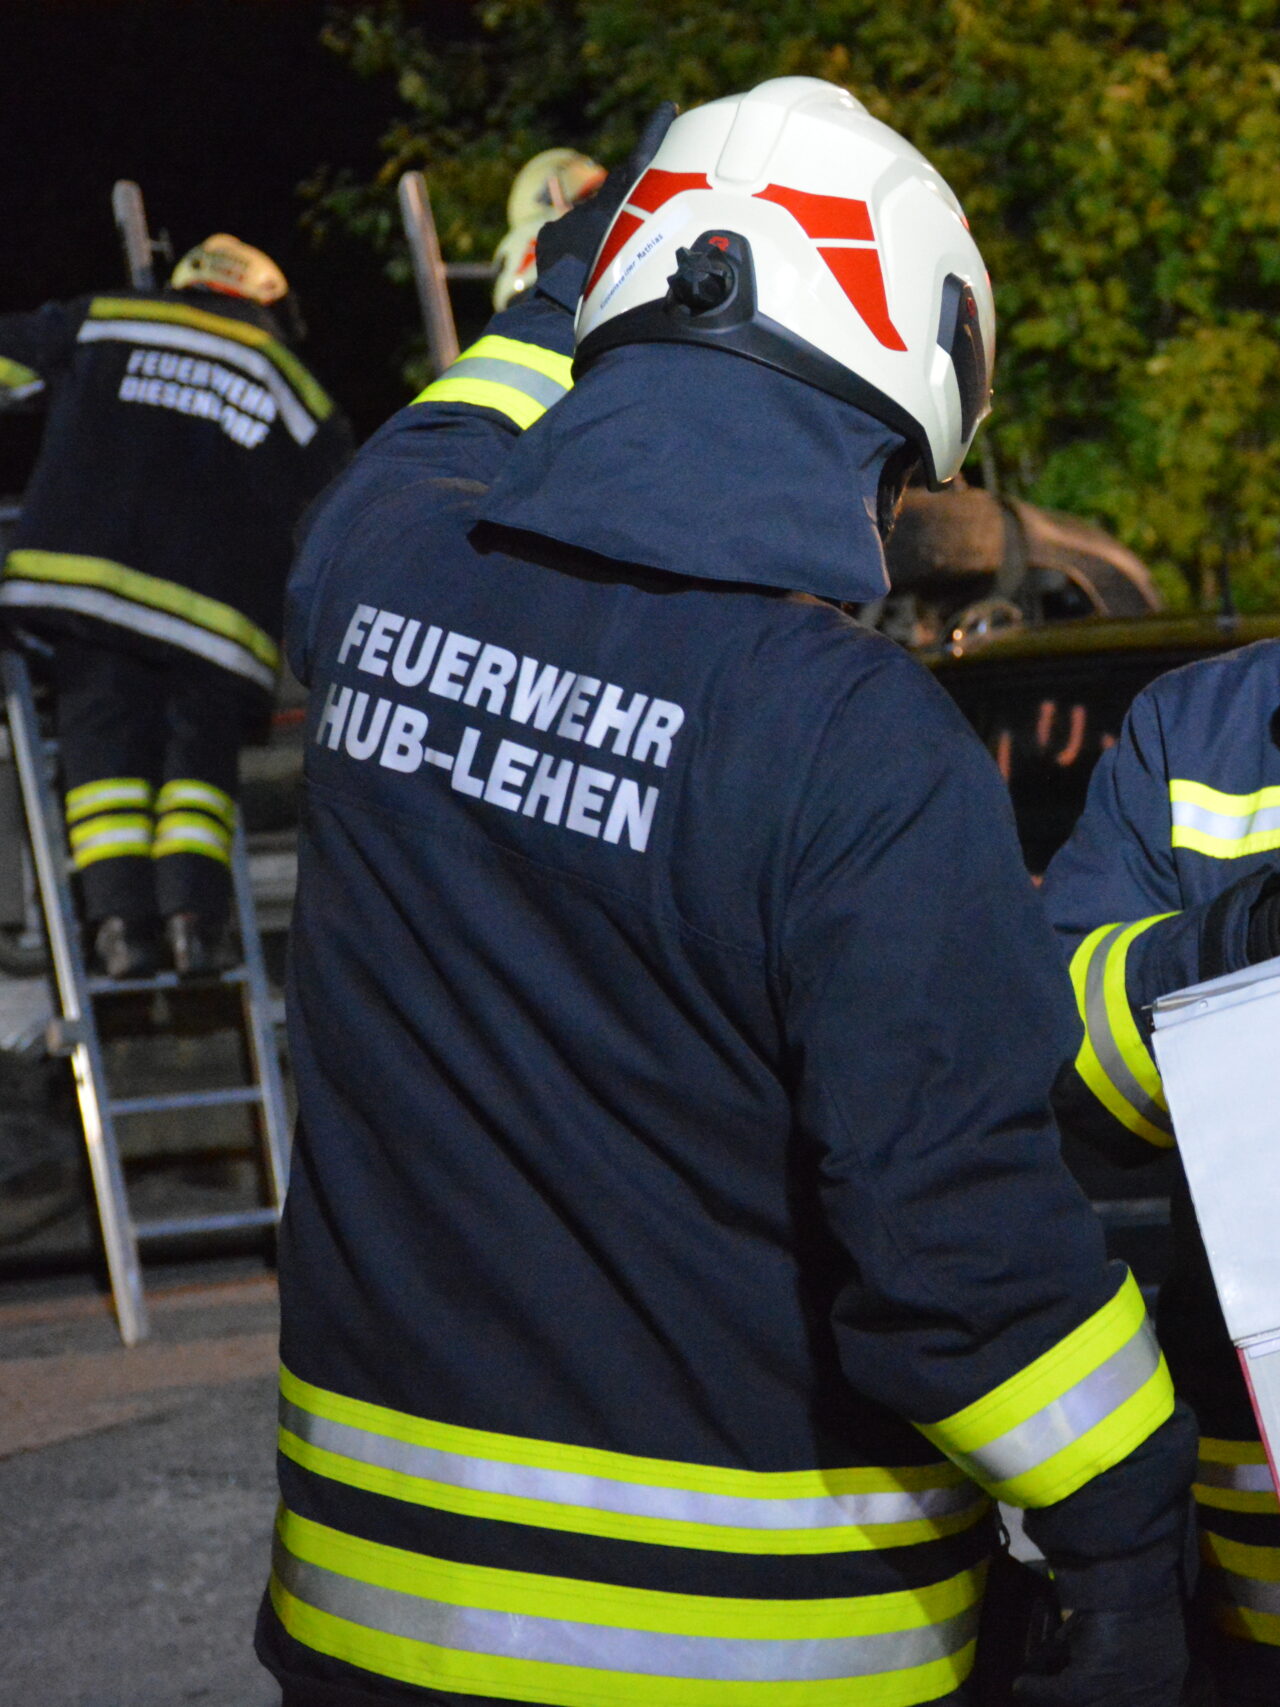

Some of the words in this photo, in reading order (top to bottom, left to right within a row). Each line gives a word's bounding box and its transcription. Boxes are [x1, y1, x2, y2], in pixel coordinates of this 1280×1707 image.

[127, 349, 277, 423] FEUERWEHR
[315, 682, 660, 853] HUB-LEHEN
[337, 603, 685, 768] FEUERWEHR
